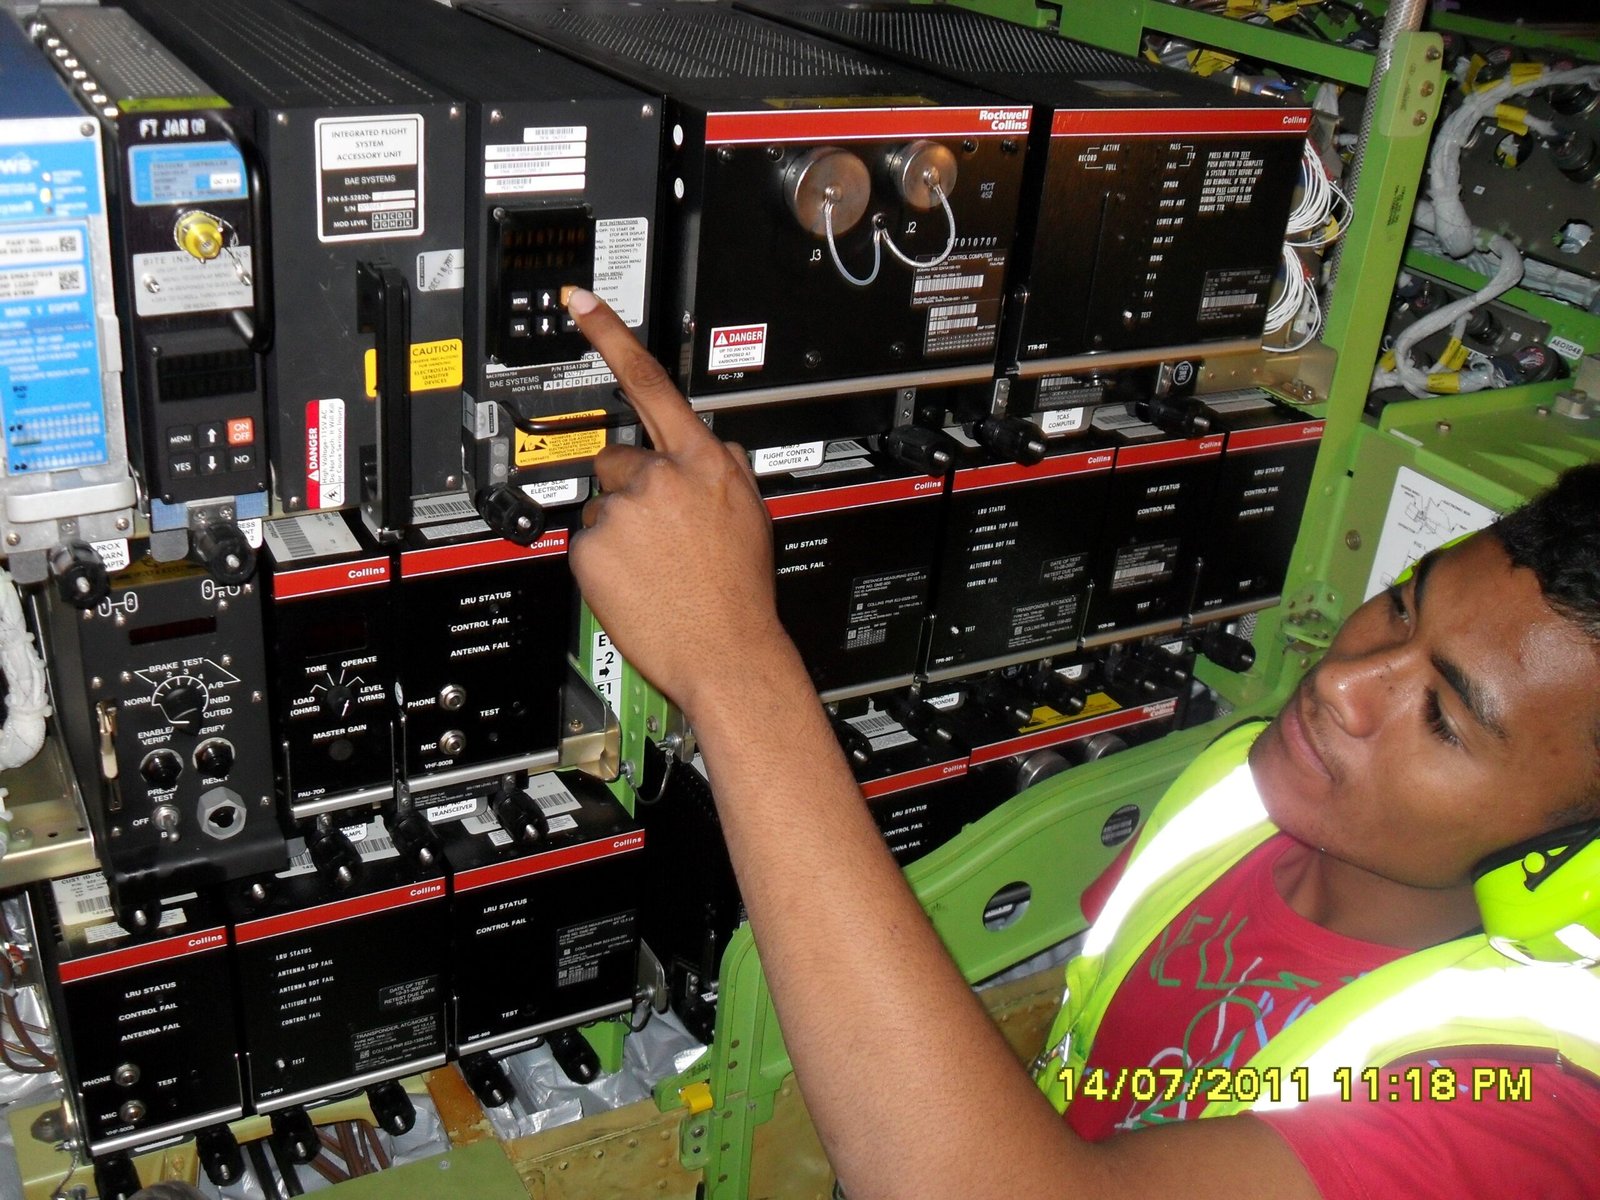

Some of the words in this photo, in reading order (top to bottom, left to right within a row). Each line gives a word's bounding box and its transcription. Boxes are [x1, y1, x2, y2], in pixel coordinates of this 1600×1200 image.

[979, 110, 1029, 120] Rockwell
[1282, 116, 1307, 125] Collins
[140, 119, 158, 138] FT
[162, 119, 189, 137] JAN
[991, 120, 1027, 131] Collins
[331, 129, 379, 139] INTEGRATED
[381, 128, 407, 136] FLIGHT
[355, 140, 384, 148] SYSTEM
[1102, 143, 1120, 152] ACTIVE
[336, 152, 381, 161] ACCESSORY
[1078, 154, 1097, 162] RECORD
[1240, 151, 1250, 159] TEST
[1105, 163, 1117, 171] FULL
[1166, 162, 1177, 170] FAIL
[344, 177, 359, 186] BAE
[361, 175, 396, 184] SYSTEMS
[1159, 199, 1175, 207] UPPER
[905, 221, 917, 233] J2
[1156, 218, 1173, 226] LOWER
[1173, 217, 1184, 225] ANT
[809, 248, 822, 262] J3
[512, 297, 528, 305] MENU
[514, 324, 525, 332] YES
[729, 330, 763, 343] DANGER
[412, 343, 458, 357] CAUTION
[489, 379, 505, 388] BAE
[505, 376, 540, 385] SYSTEMS
[233, 423, 249, 431] ON
[1048, 419, 1076, 429] COMPUTER
[170, 434, 192, 444] MENU
[233, 432, 250, 441] OFF
[308, 427, 318, 470] DANGER
[1199, 440, 1221, 450] Collins
[762, 452, 785, 460] FLIGHT
[786, 447, 816, 457] CONTROL
[233, 455, 250, 464] NO
[768, 457, 802, 467] COMPUTER
[1087, 455, 1111, 464] Collins
[174, 462, 192, 472] YES
[530, 484, 569, 495] ELECTRONIC
[914, 481, 942, 491] Collins
[1147, 485, 1158, 494] LRU
[1159, 483, 1180, 492] STATUS
[1137, 506, 1163, 516] CONTROL
[1163, 504, 1176, 512] FAIL
[530, 538, 565, 550] Collins
[800, 538, 828, 548] STATUS
[348, 566, 385, 579] Collins
[218, 590, 226, 598] R
[460, 596, 477, 606] LRU
[478, 591, 512, 602] STATUS
[1137, 601, 1151, 609] TEST
[451, 620, 490, 633] CONTROL
[491, 617, 510, 626] FAIL
[450, 644, 490, 658] ANTENNA
[492, 641, 511, 650] FAIL
[148, 662, 179, 673] BRAKE
[182, 657, 204, 667] TEST
[305, 664, 328, 674] TONE
[341, 655, 378, 668] OPERATE
[183, 667, 189, 675] 3
[207, 681, 224, 690] A/B
[360, 684, 384, 694] LEVEL
[123, 695, 151, 707] NORM
[209, 695, 231, 704] INBD
[292, 696, 315, 706] LOAD
[357, 692, 386, 704] (VRMS)
[407, 697, 436, 709] PHONE
[203, 707, 233, 719] OUTBD
[290, 705, 321, 717] (OHMS)
[480, 707, 500, 718] TEST
[137, 726, 175, 739] ENABLE/
[312, 728, 346, 740] MASTER
[347, 724, 367, 733] GAIN
[141, 734, 172, 746] VERIFY
[420, 742, 437, 752] MIC
[942, 763, 967, 774] Collins
[153, 793, 175, 803] TEST
[297, 788, 326, 799] PAU-700
[431, 803, 473, 818] TRANSCEIVER
[904, 804, 928, 815] STATUS
[132, 817, 150, 827] OFF
[613, 836, 642, 849] Collins
[410, 884, 441, 897] Collins
[483, 905, 498, 914] LRU
[499, 898, 528, 910] STATUS
[475, 922, 510, 935] CONTROL
[511, 917, 527, 927] FAIL
[188, 933, 223, 947] Collins
[275, 953, 288, 961] LRU
[289, 947, 313, 959] STATUS
[277, 966, 306, 978] ANTENNA
[307, 962, 319, 971] TOP
[321, 959, 334, 967] FAIL
[125, 989, 142, 999] LRU
[143, 981, 177, 995] STATUS
[278, 982, 307, 994] ANTENNA
[308, 978, 320, 987] BOT
[321, 975, 335, 984] FAIL
[280, 998, 308, 1011] ALTITUDE
[309, 995, 322, 1003] FAIL
[118, 1007, 158, 1022] CONTROL
[159, 1002, 179, 1012] FAIL
[501, 1009, 519, 1019] TEST
[281, 1014, 307, 1027] CONTROL
[308, 1011, 322, 1020] FAIL
[120, 1027, 161, 1042] ANTENNA
[162, 1022, 181, 1032] FAIL
[292, 1057, 305, 1066] TEST
[81, 1074, 112, 1087] PHONE
[157, 1077, 178, 1087] TEST
[101, 1111, 118, 1121] MIC
